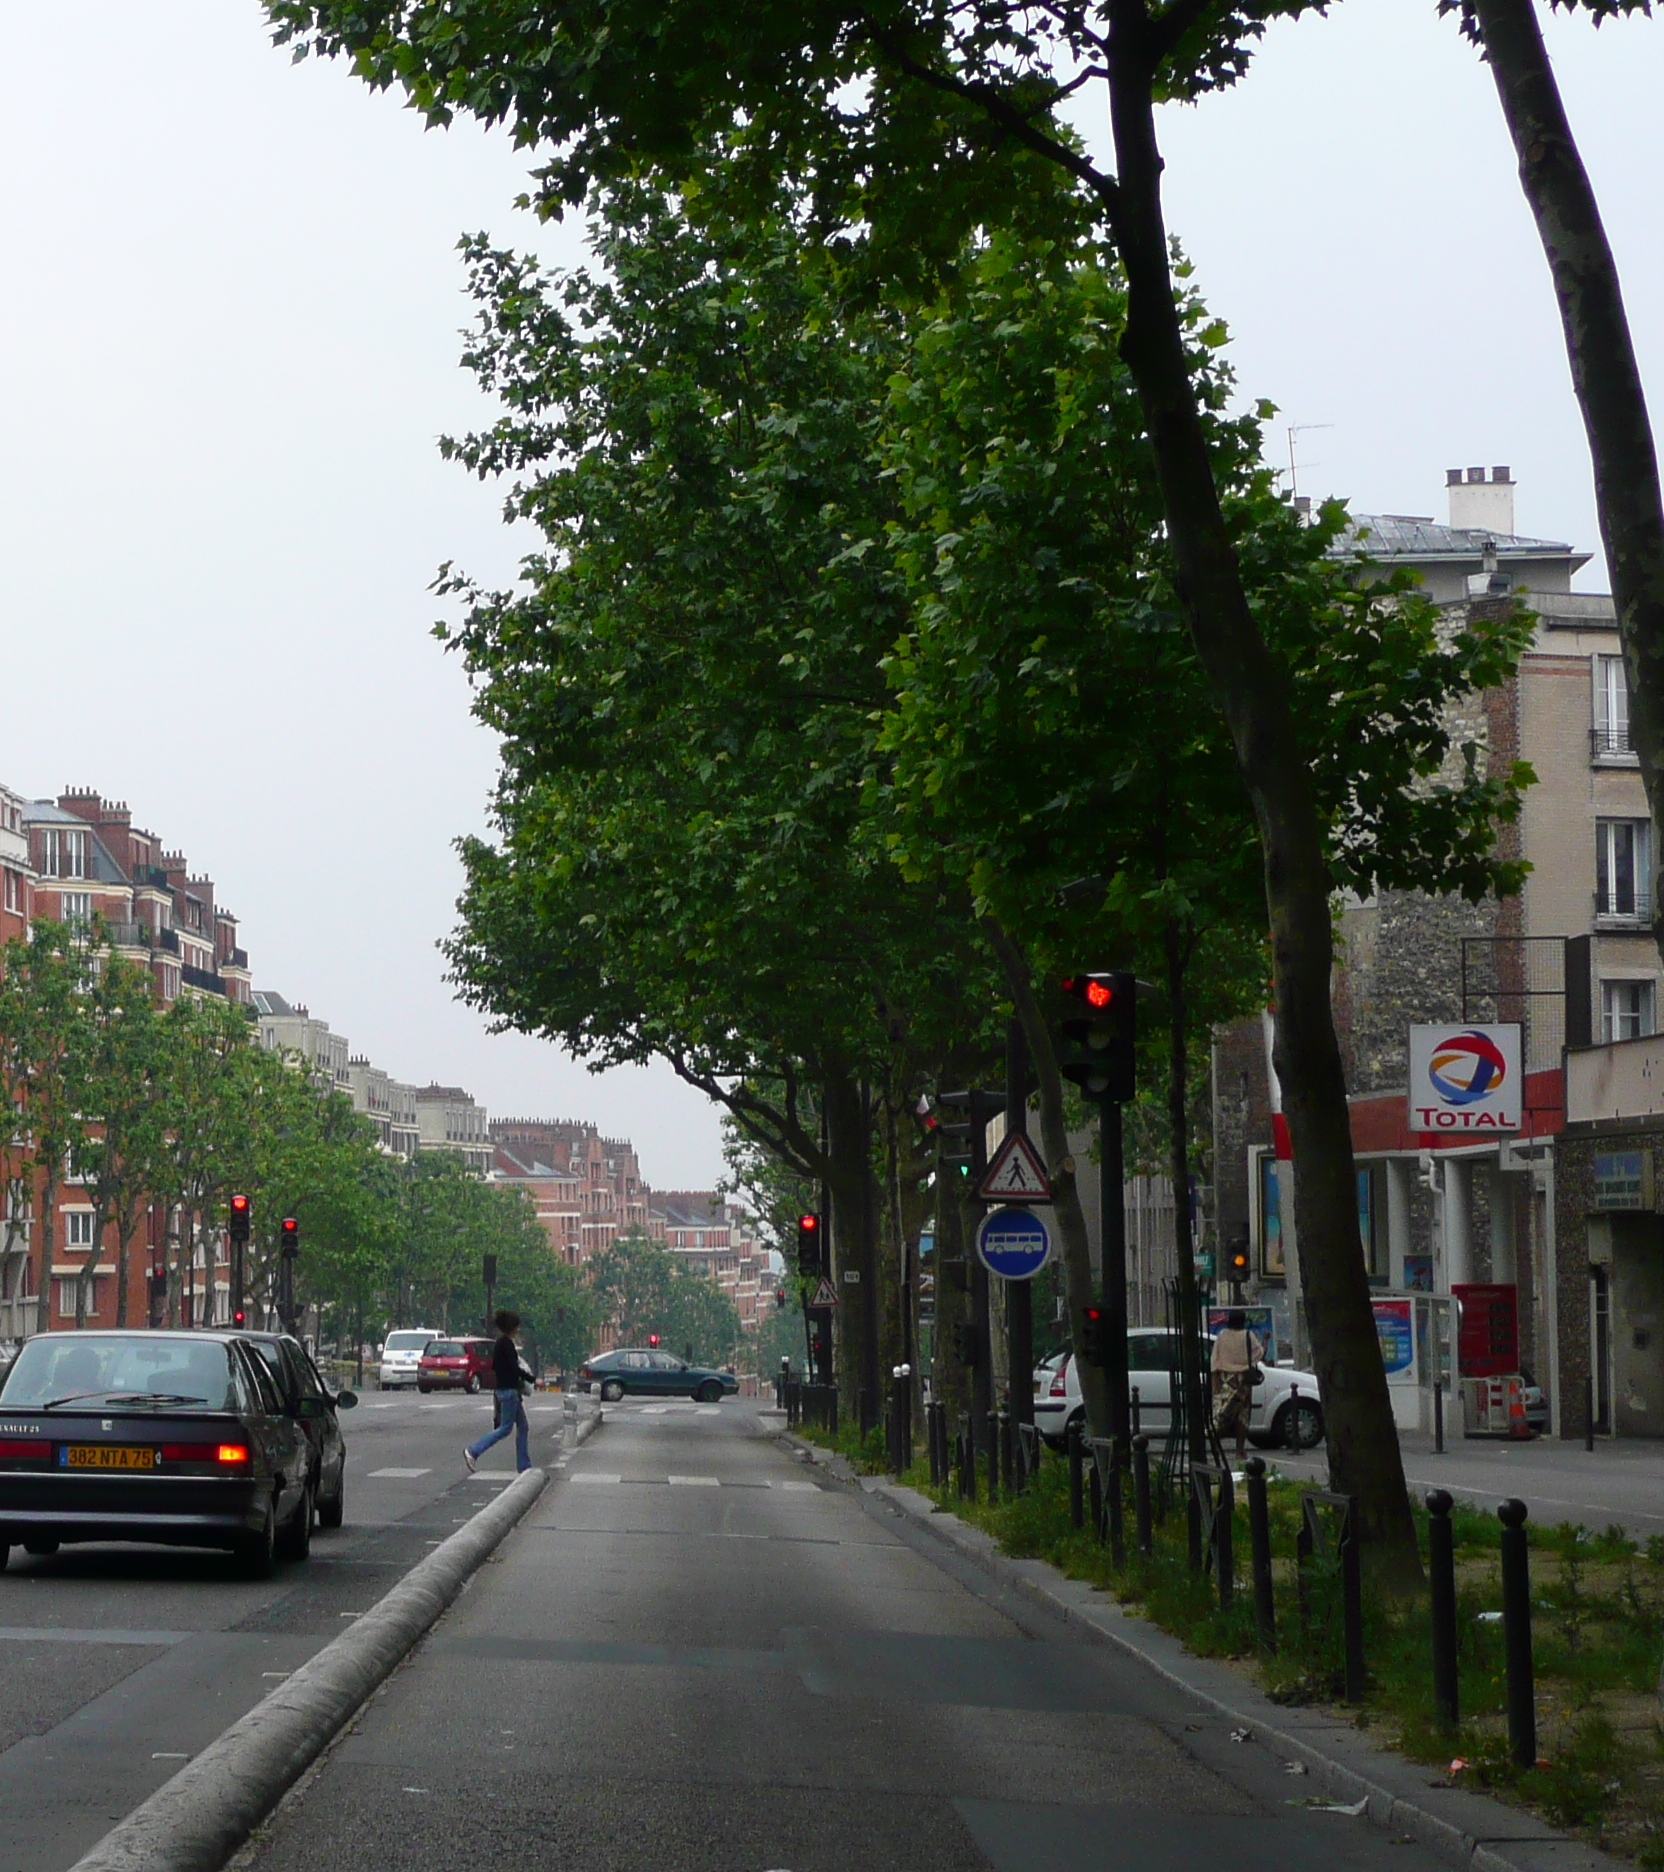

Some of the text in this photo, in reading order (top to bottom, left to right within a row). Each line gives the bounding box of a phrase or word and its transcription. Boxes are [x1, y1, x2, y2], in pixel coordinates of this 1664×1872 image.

[1416, 1108, 1516, 1127] TOTAL
[69, 1449, 151, 1467] 382 NTA 75
